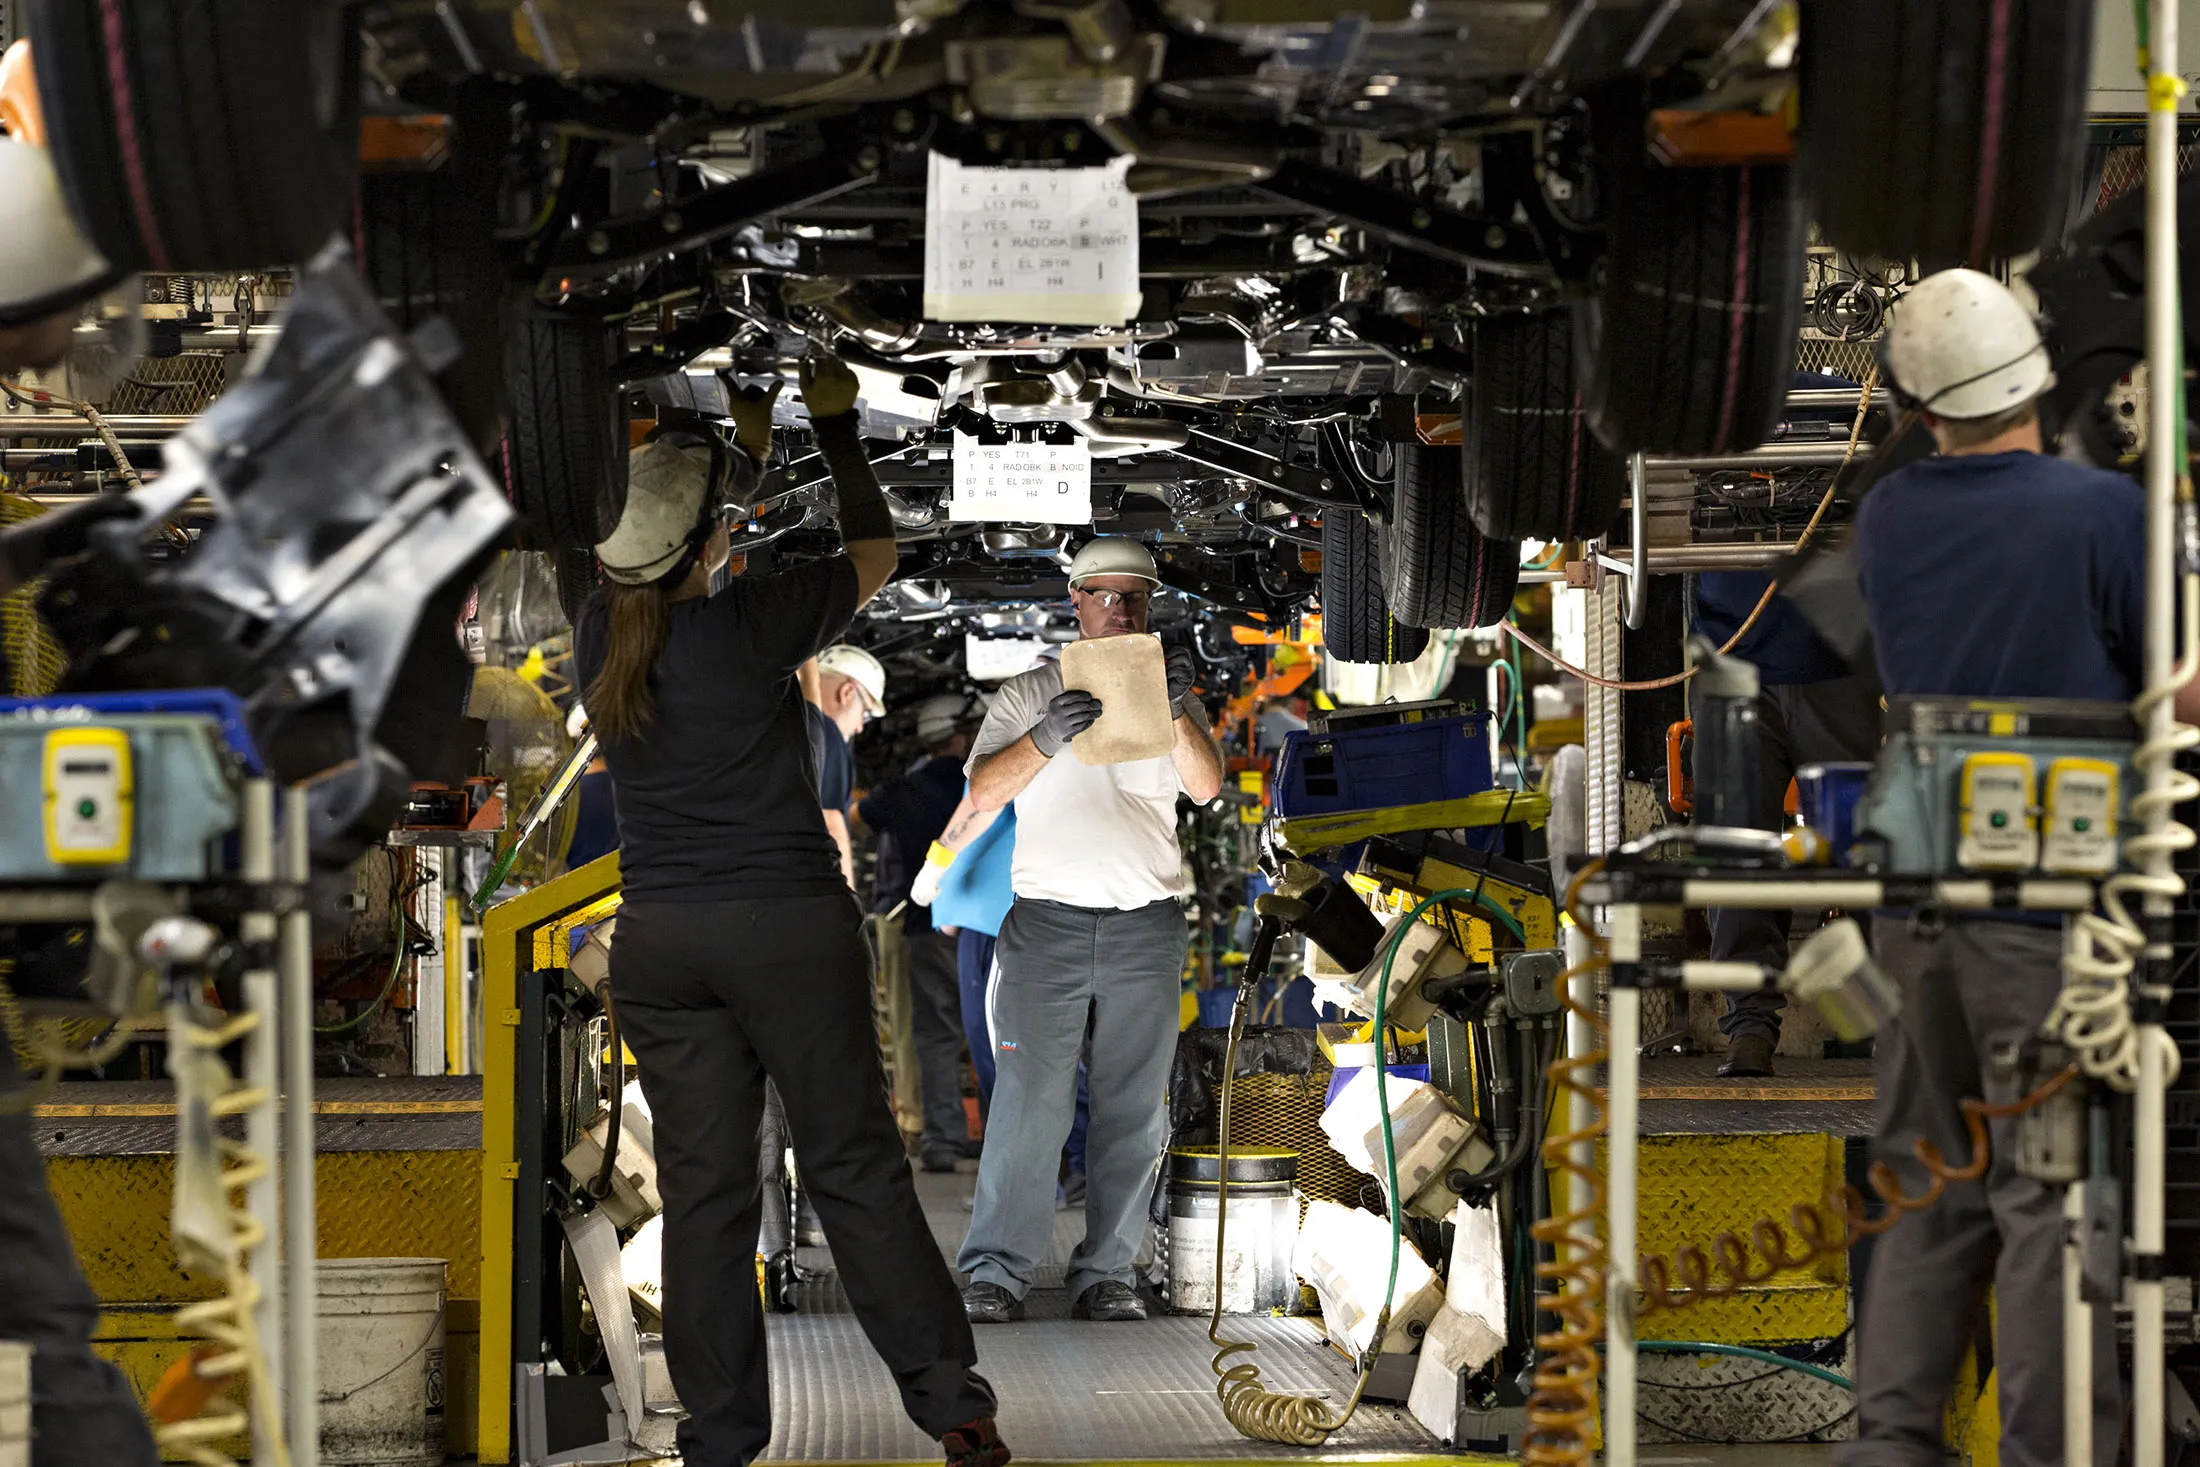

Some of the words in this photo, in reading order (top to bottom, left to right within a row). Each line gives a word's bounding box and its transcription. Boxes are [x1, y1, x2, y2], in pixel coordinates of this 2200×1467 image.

[961, 219, 971, 231] P
[982, 219, 1009, 230] YES
[1030, 218, 1053, 230] T22
[968, 450, 975, 458] P
[982, 450, 1001, 459] YES
[1015, 450, 1029, 459] T71
[1050, 450, 1057, 459] P
[988, 463, 994, 471] 4
[1003, 463, 1022, 471] RAD
[1050, 463, 1057, 471] B
[966, 477, 977, 486] B7
[988, 477, 995, 486] E
[1006, 477, 1018, 486] EL
[1057, 481, 1069, 494] D
[968, 489, 975, 498] B
[985, 489, 997, 498] H4
[1026, 490, 1038, 498] H4
